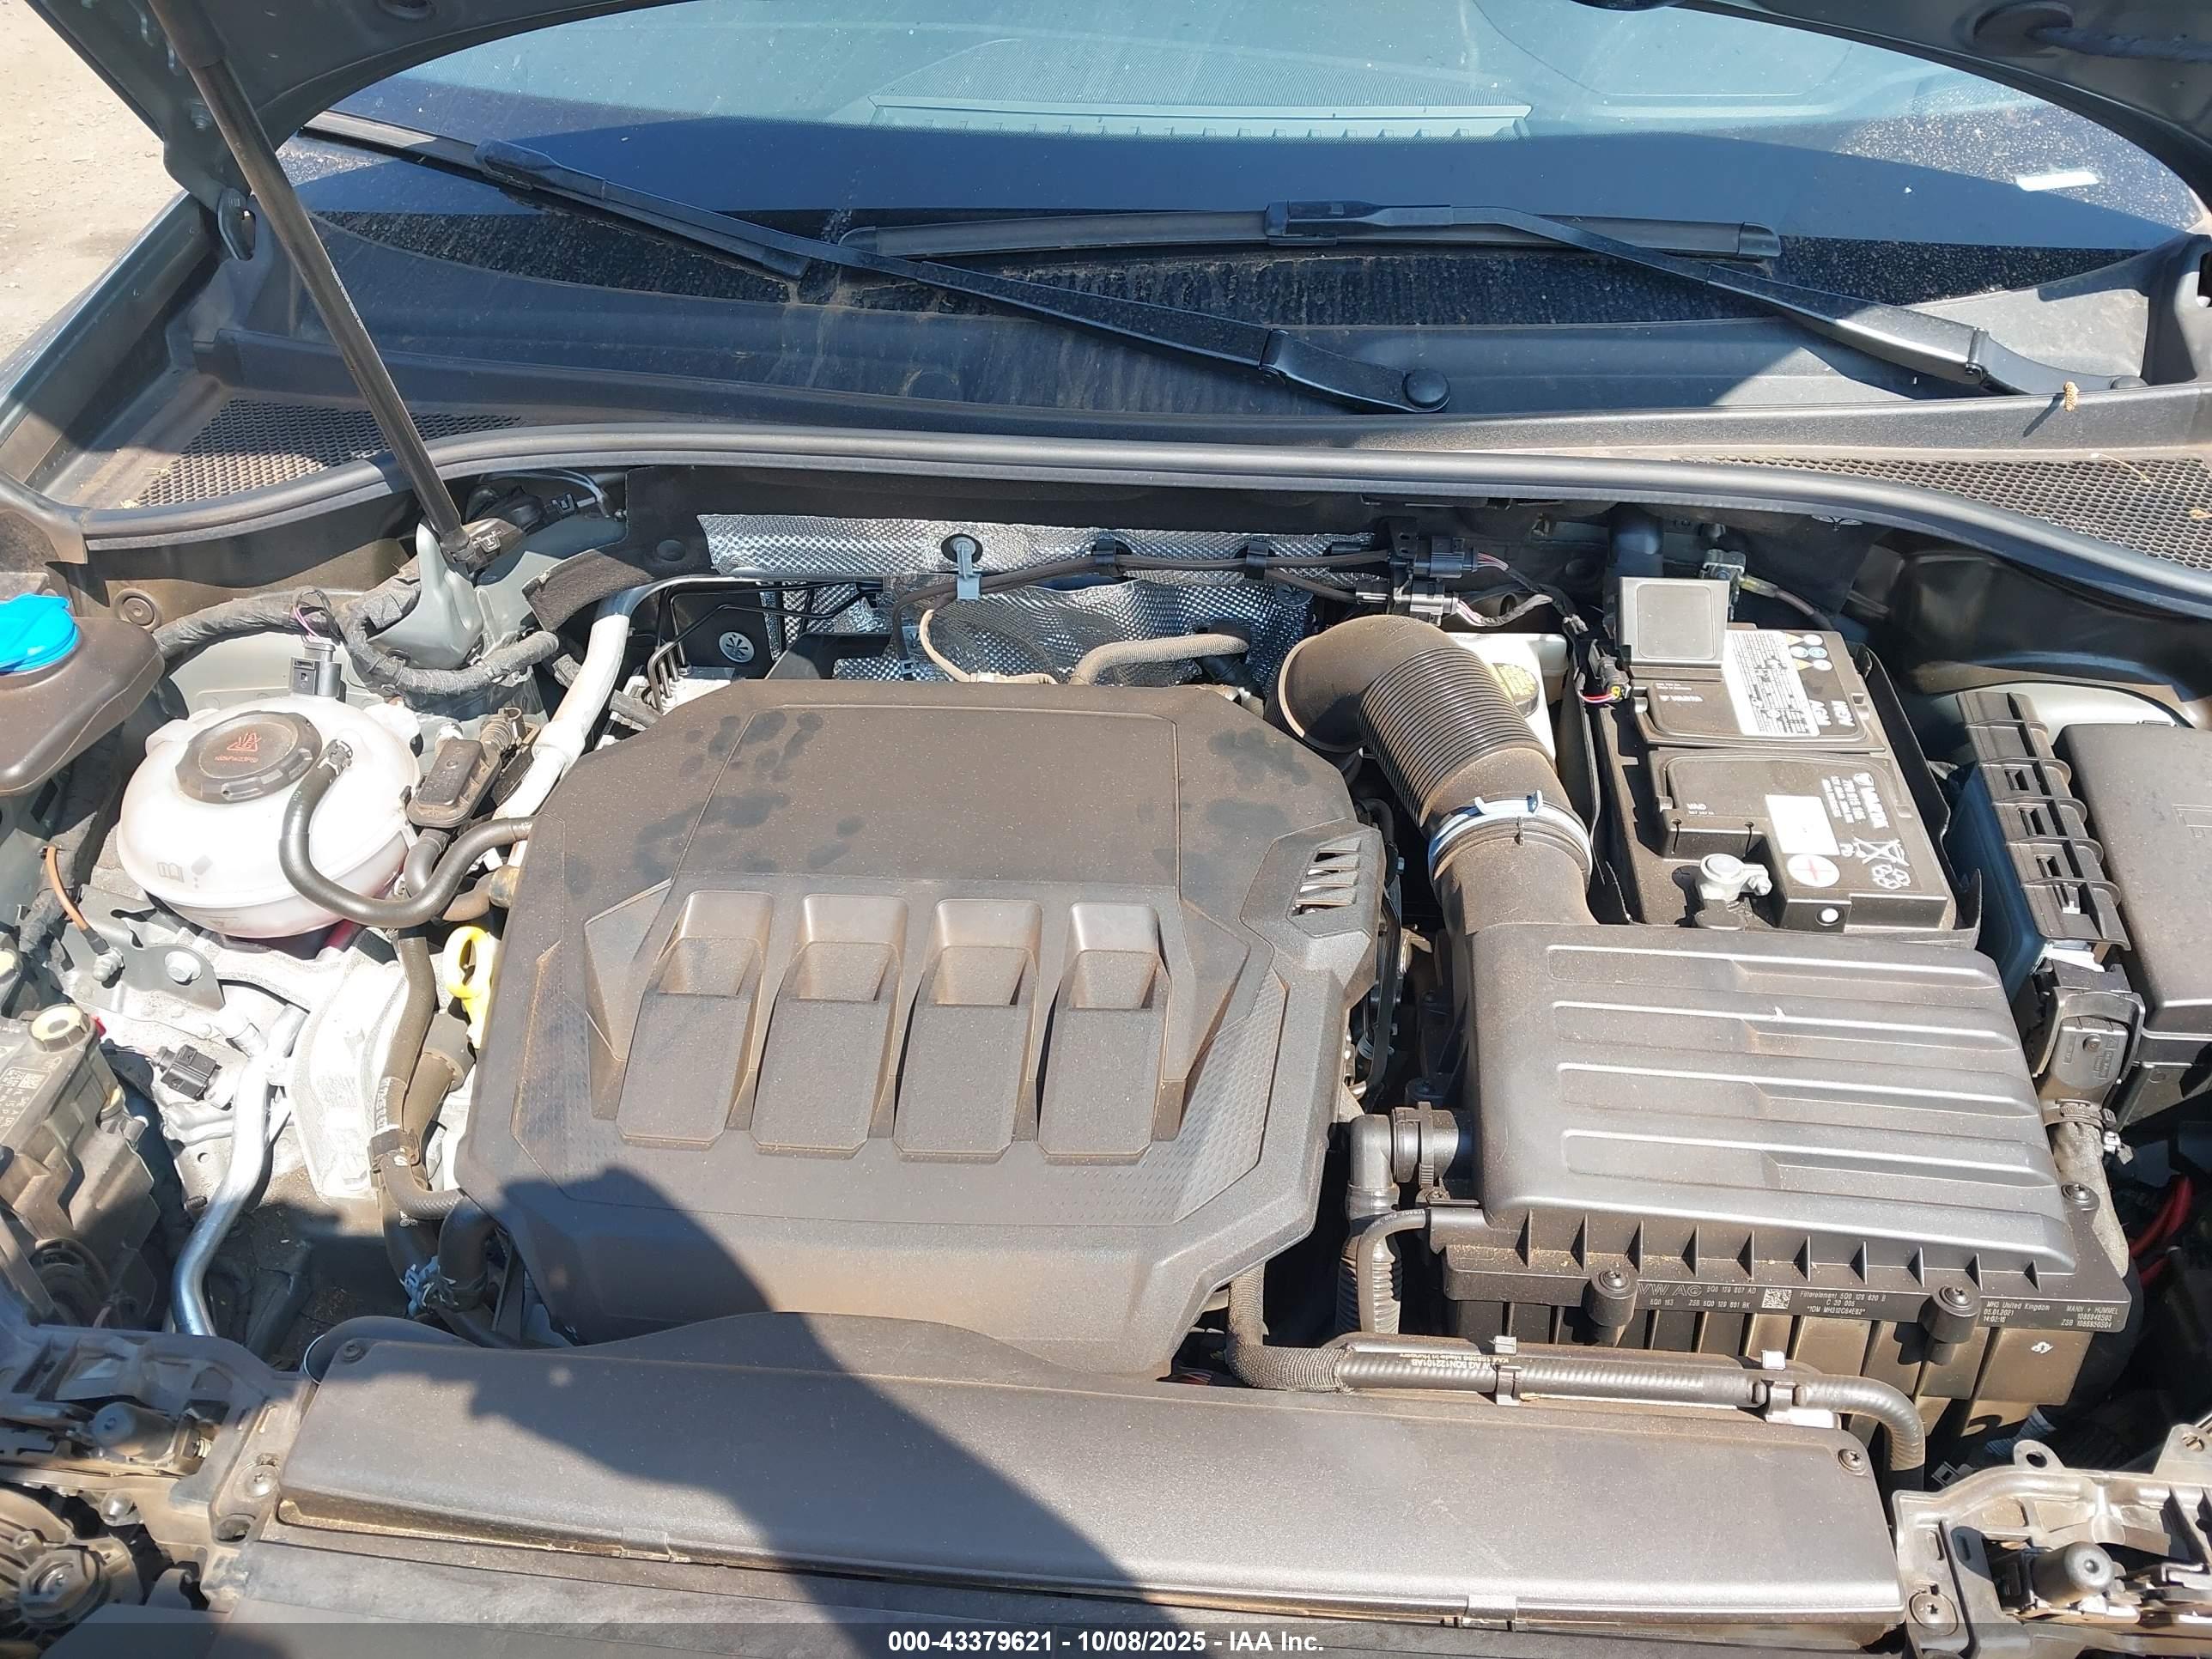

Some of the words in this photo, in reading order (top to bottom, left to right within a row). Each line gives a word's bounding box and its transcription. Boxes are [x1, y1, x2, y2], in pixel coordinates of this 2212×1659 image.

[1637, 1282, 1670, 1296] VW
[1672, 1284, 1703, 1297] AG
[2002, 1301, 2022, 1310] United
[2024, 1303, 2051, 1312] Kingdom
[2066, 1304, 2085, 1313] MANN
